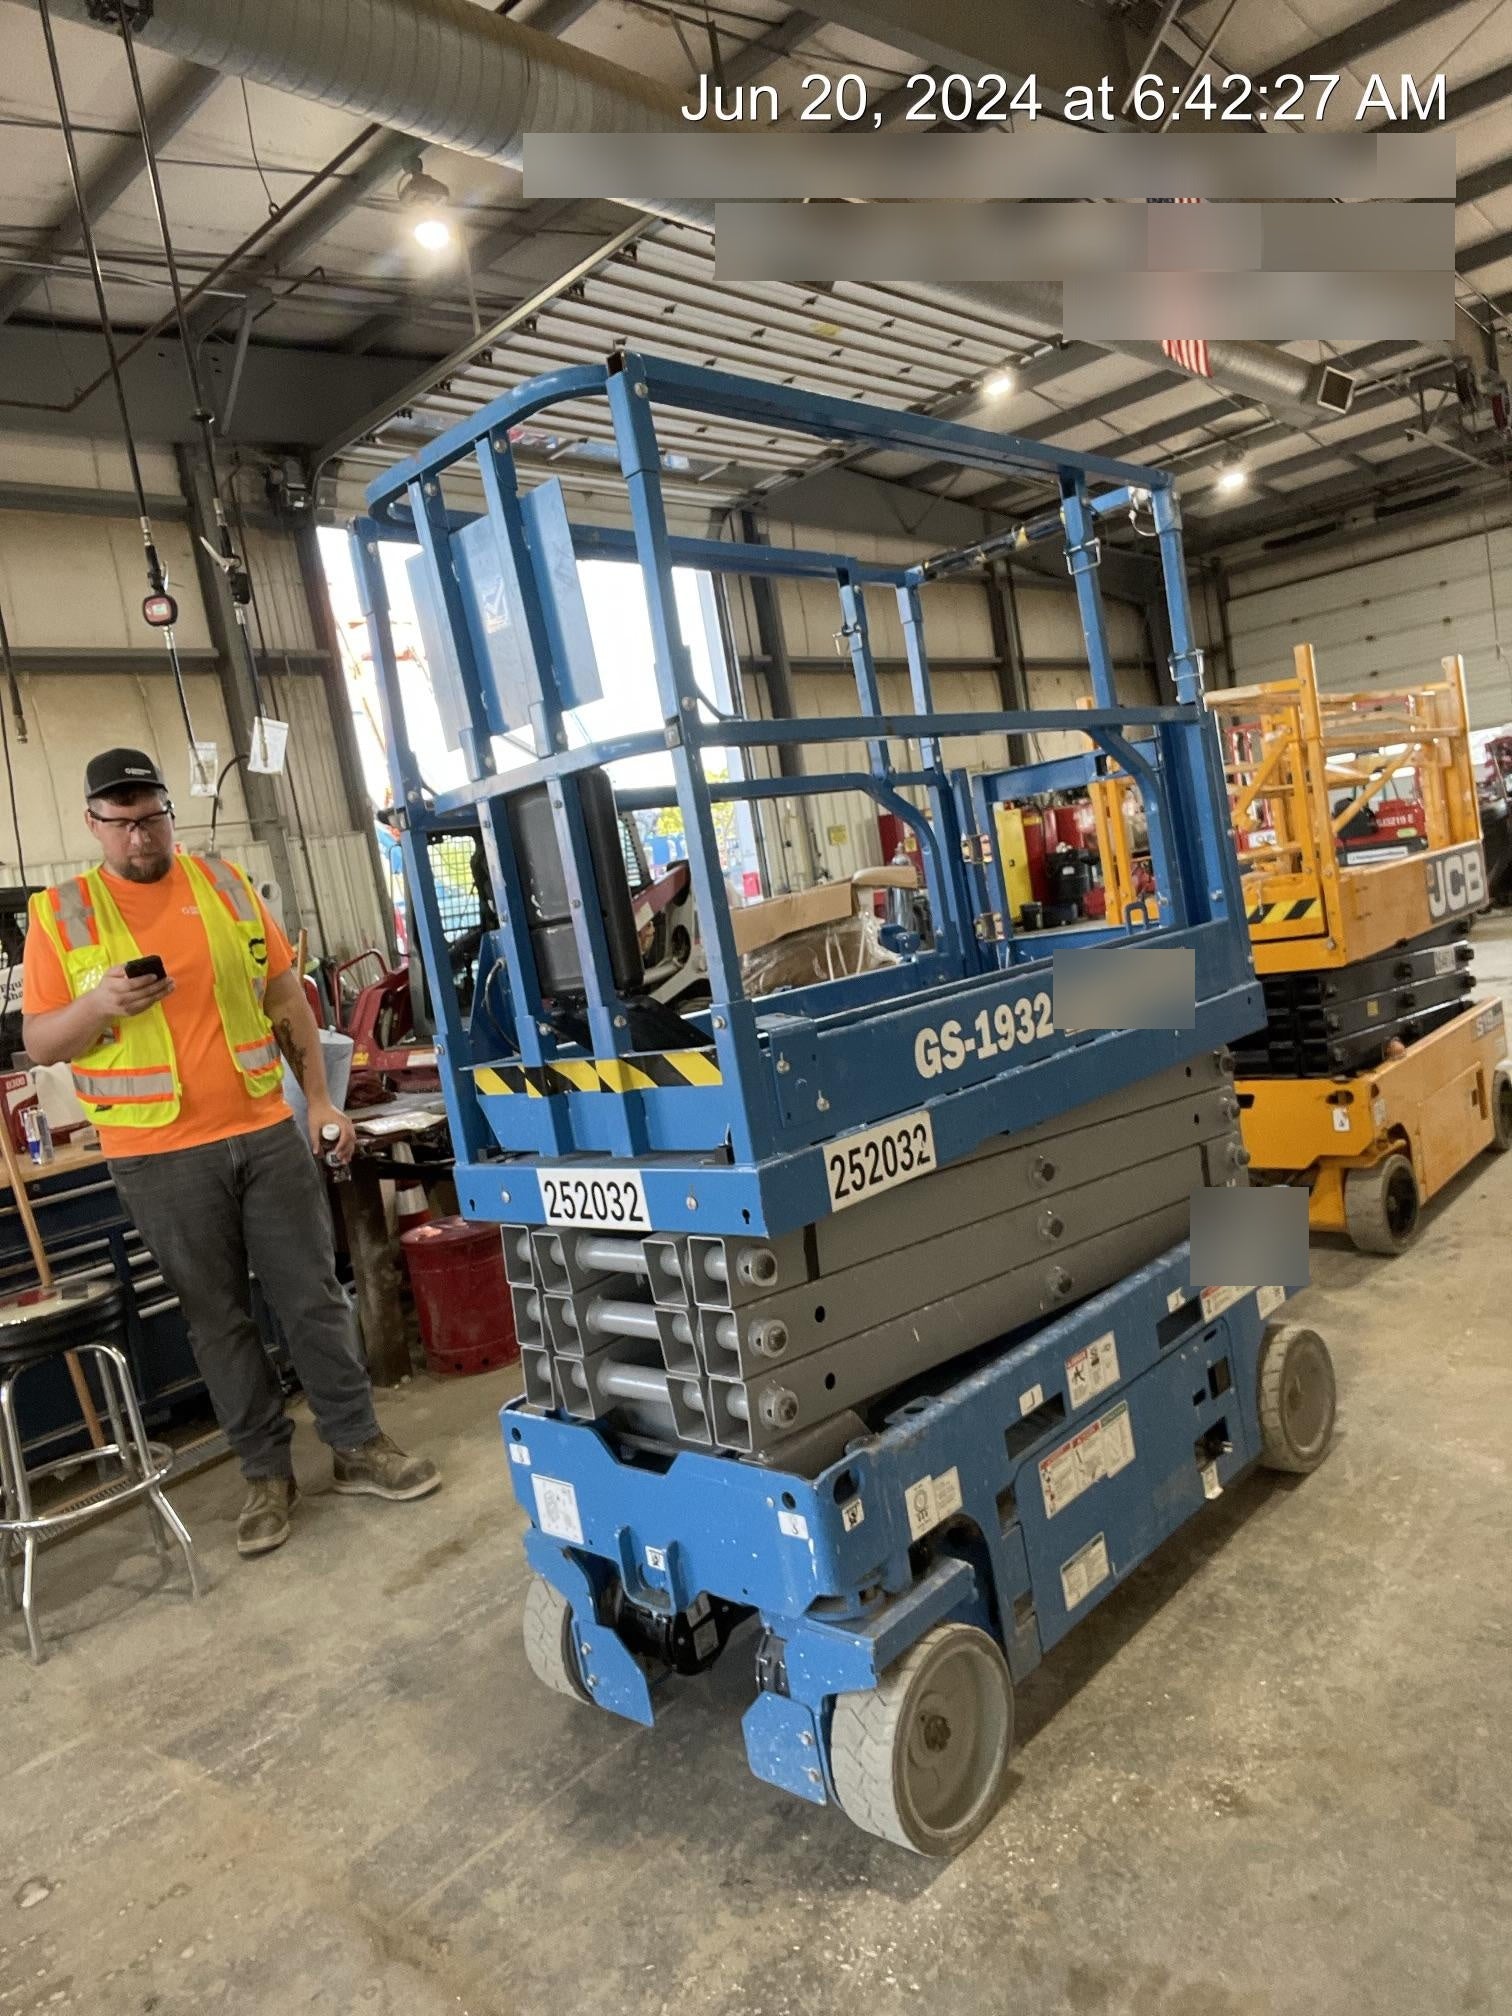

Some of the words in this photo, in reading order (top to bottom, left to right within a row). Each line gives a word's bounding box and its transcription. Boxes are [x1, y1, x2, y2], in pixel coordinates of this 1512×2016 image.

[1426, 850, 1485, 918] JCB
[914, 991, 1055, 1079] GS-1932
[829, 1123, 931, 1200] 252032
[544, 1180, 644, 1222] 252032
